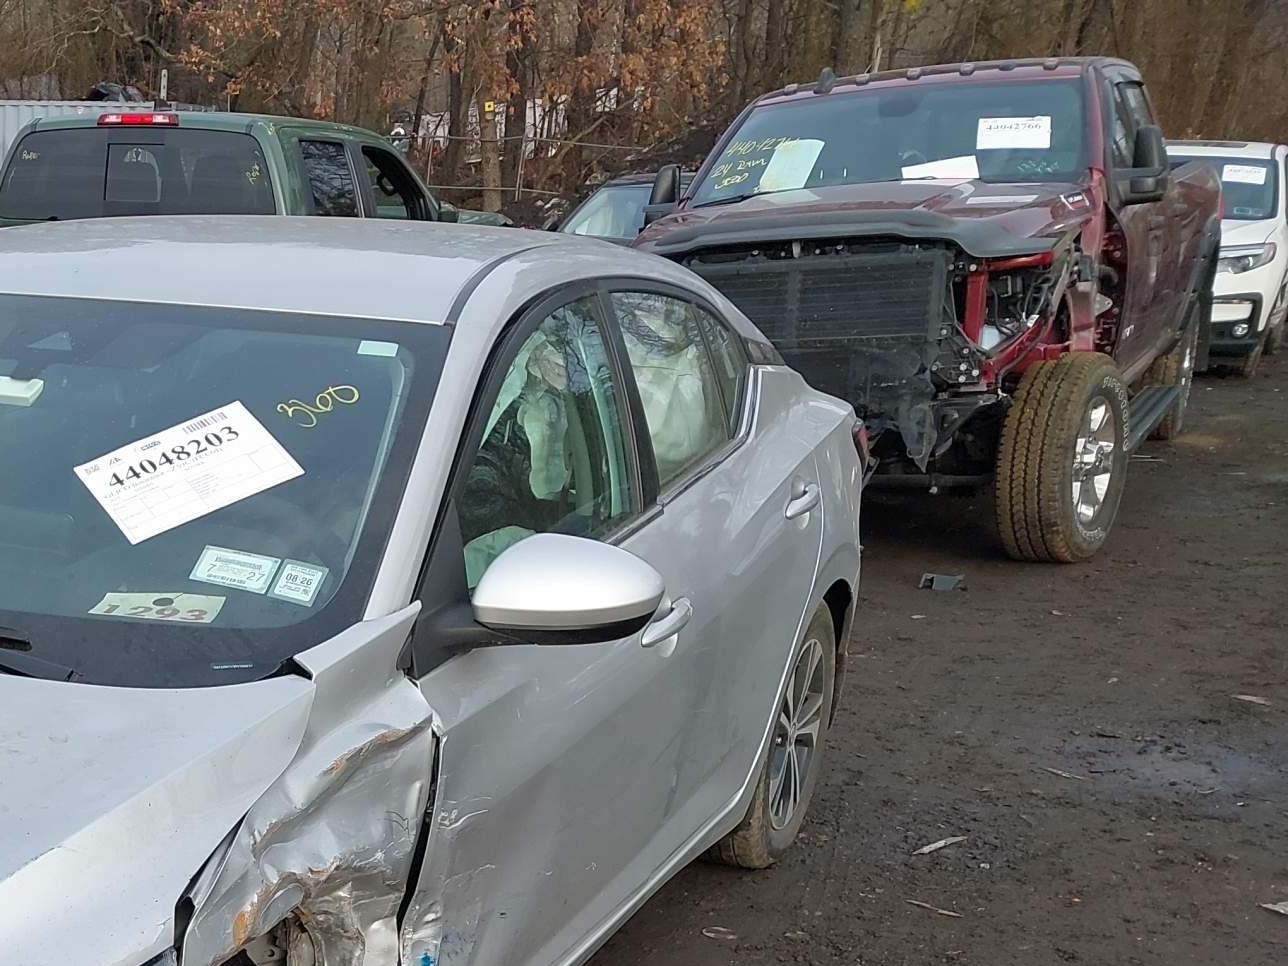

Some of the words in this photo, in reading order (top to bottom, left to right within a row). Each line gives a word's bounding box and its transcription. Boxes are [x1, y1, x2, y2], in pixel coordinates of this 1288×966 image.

[109, 425, 240, 487] 44048203
[207, 563, 217, 573] 7
[246, 571, 266, 582] 27
[103, 603, 209, 621] 1293
